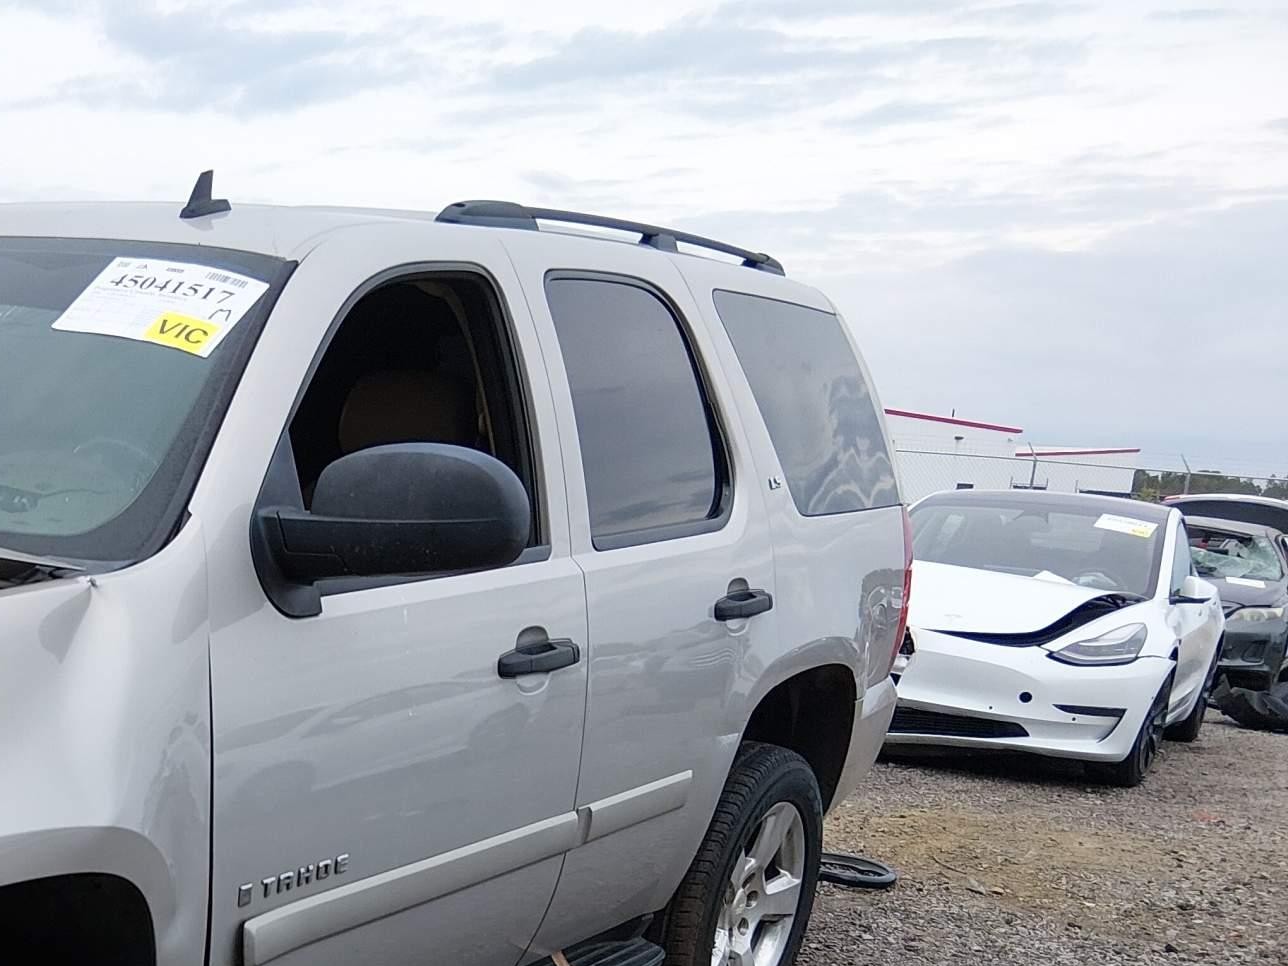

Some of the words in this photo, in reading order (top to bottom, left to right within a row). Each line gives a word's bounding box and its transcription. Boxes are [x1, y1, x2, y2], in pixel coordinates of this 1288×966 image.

[110, 273, 235, 304] 45041517
[158, 318, 209, 345] VIC
[261, 853, 350, 899] TAHOE
